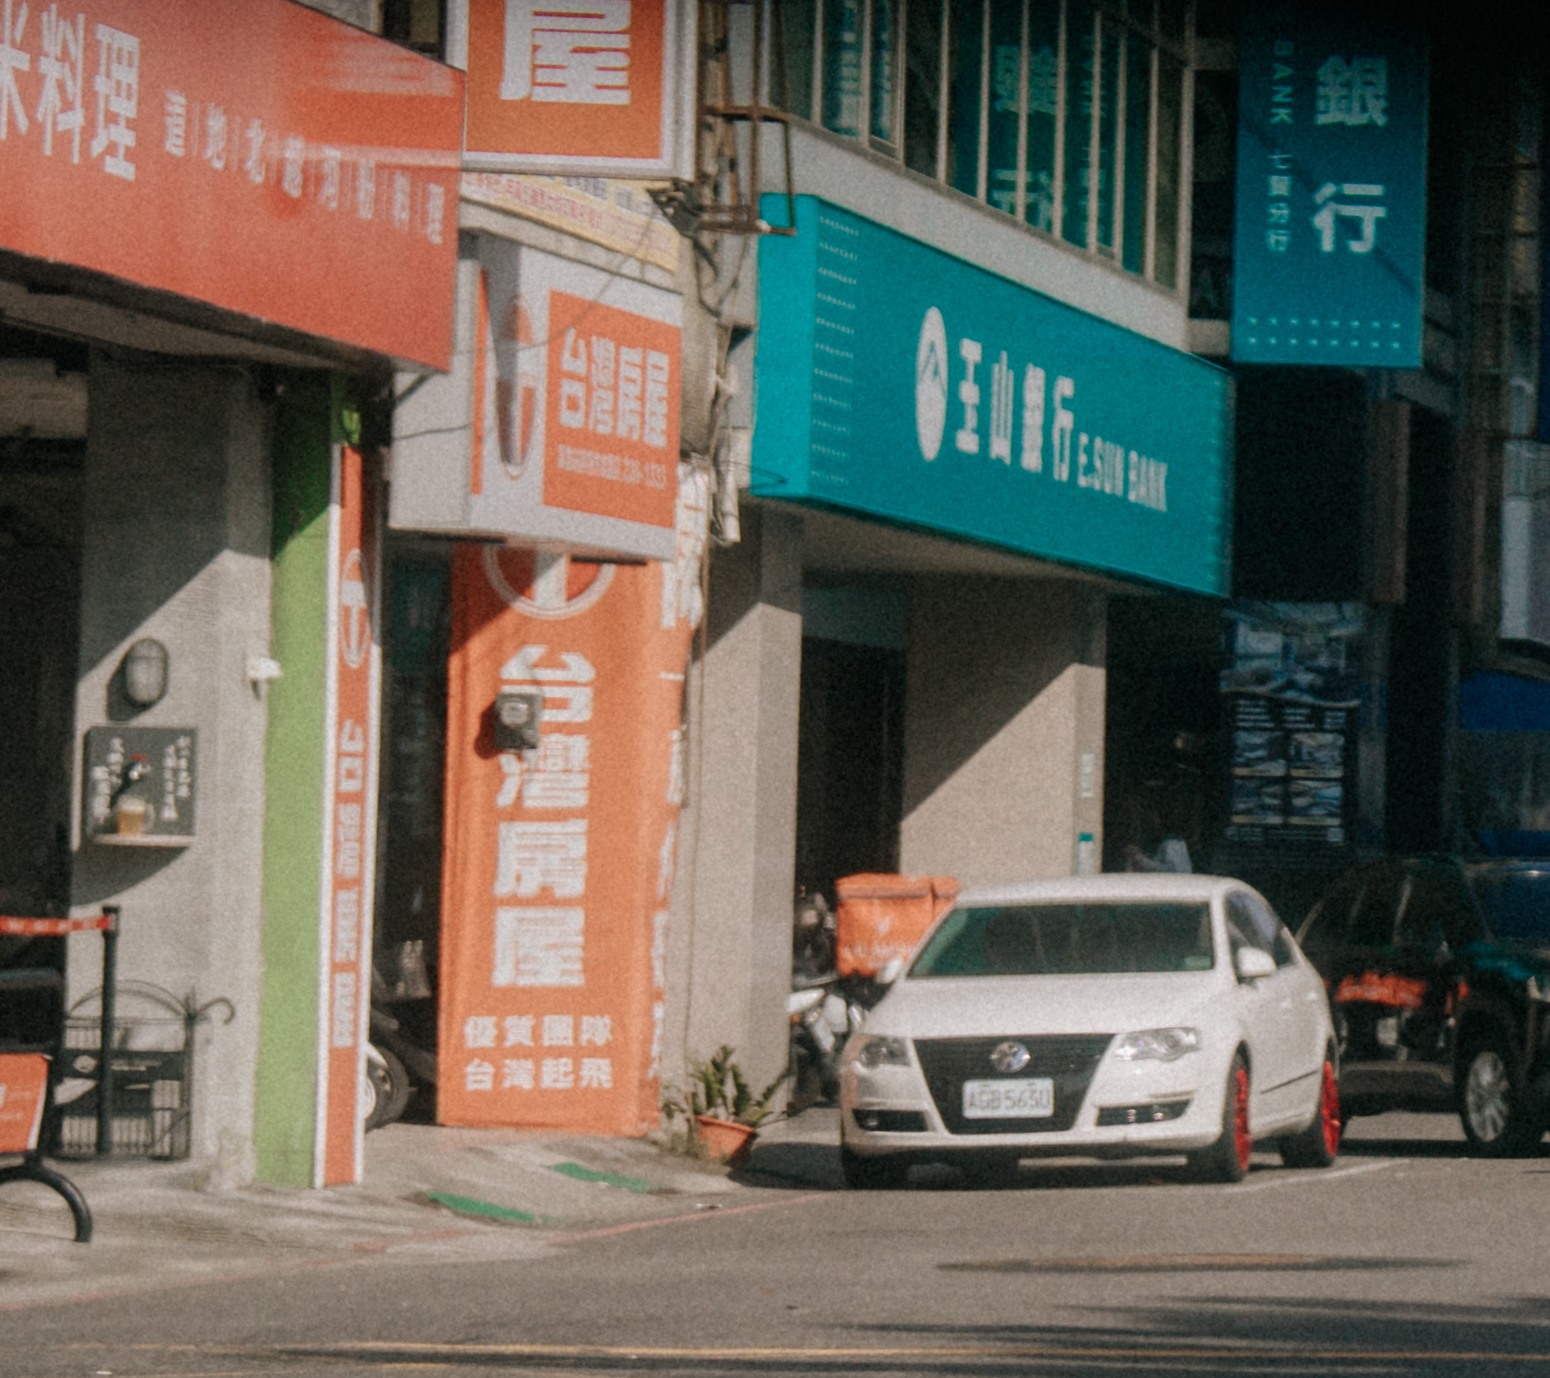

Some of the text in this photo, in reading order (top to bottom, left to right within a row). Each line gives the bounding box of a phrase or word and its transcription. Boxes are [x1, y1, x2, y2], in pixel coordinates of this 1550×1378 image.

[1270, 39, 1294, 125] BANK
[1312, 53, 1389, 253] 銀行
[955, 337, 1074, 482] 玉山銀行
[1128, 449, 1168, 512] BANK
[463, 1015, 613, 1050] 優質團隊
[463, 1056, 613, 1091] 台灣起飛
